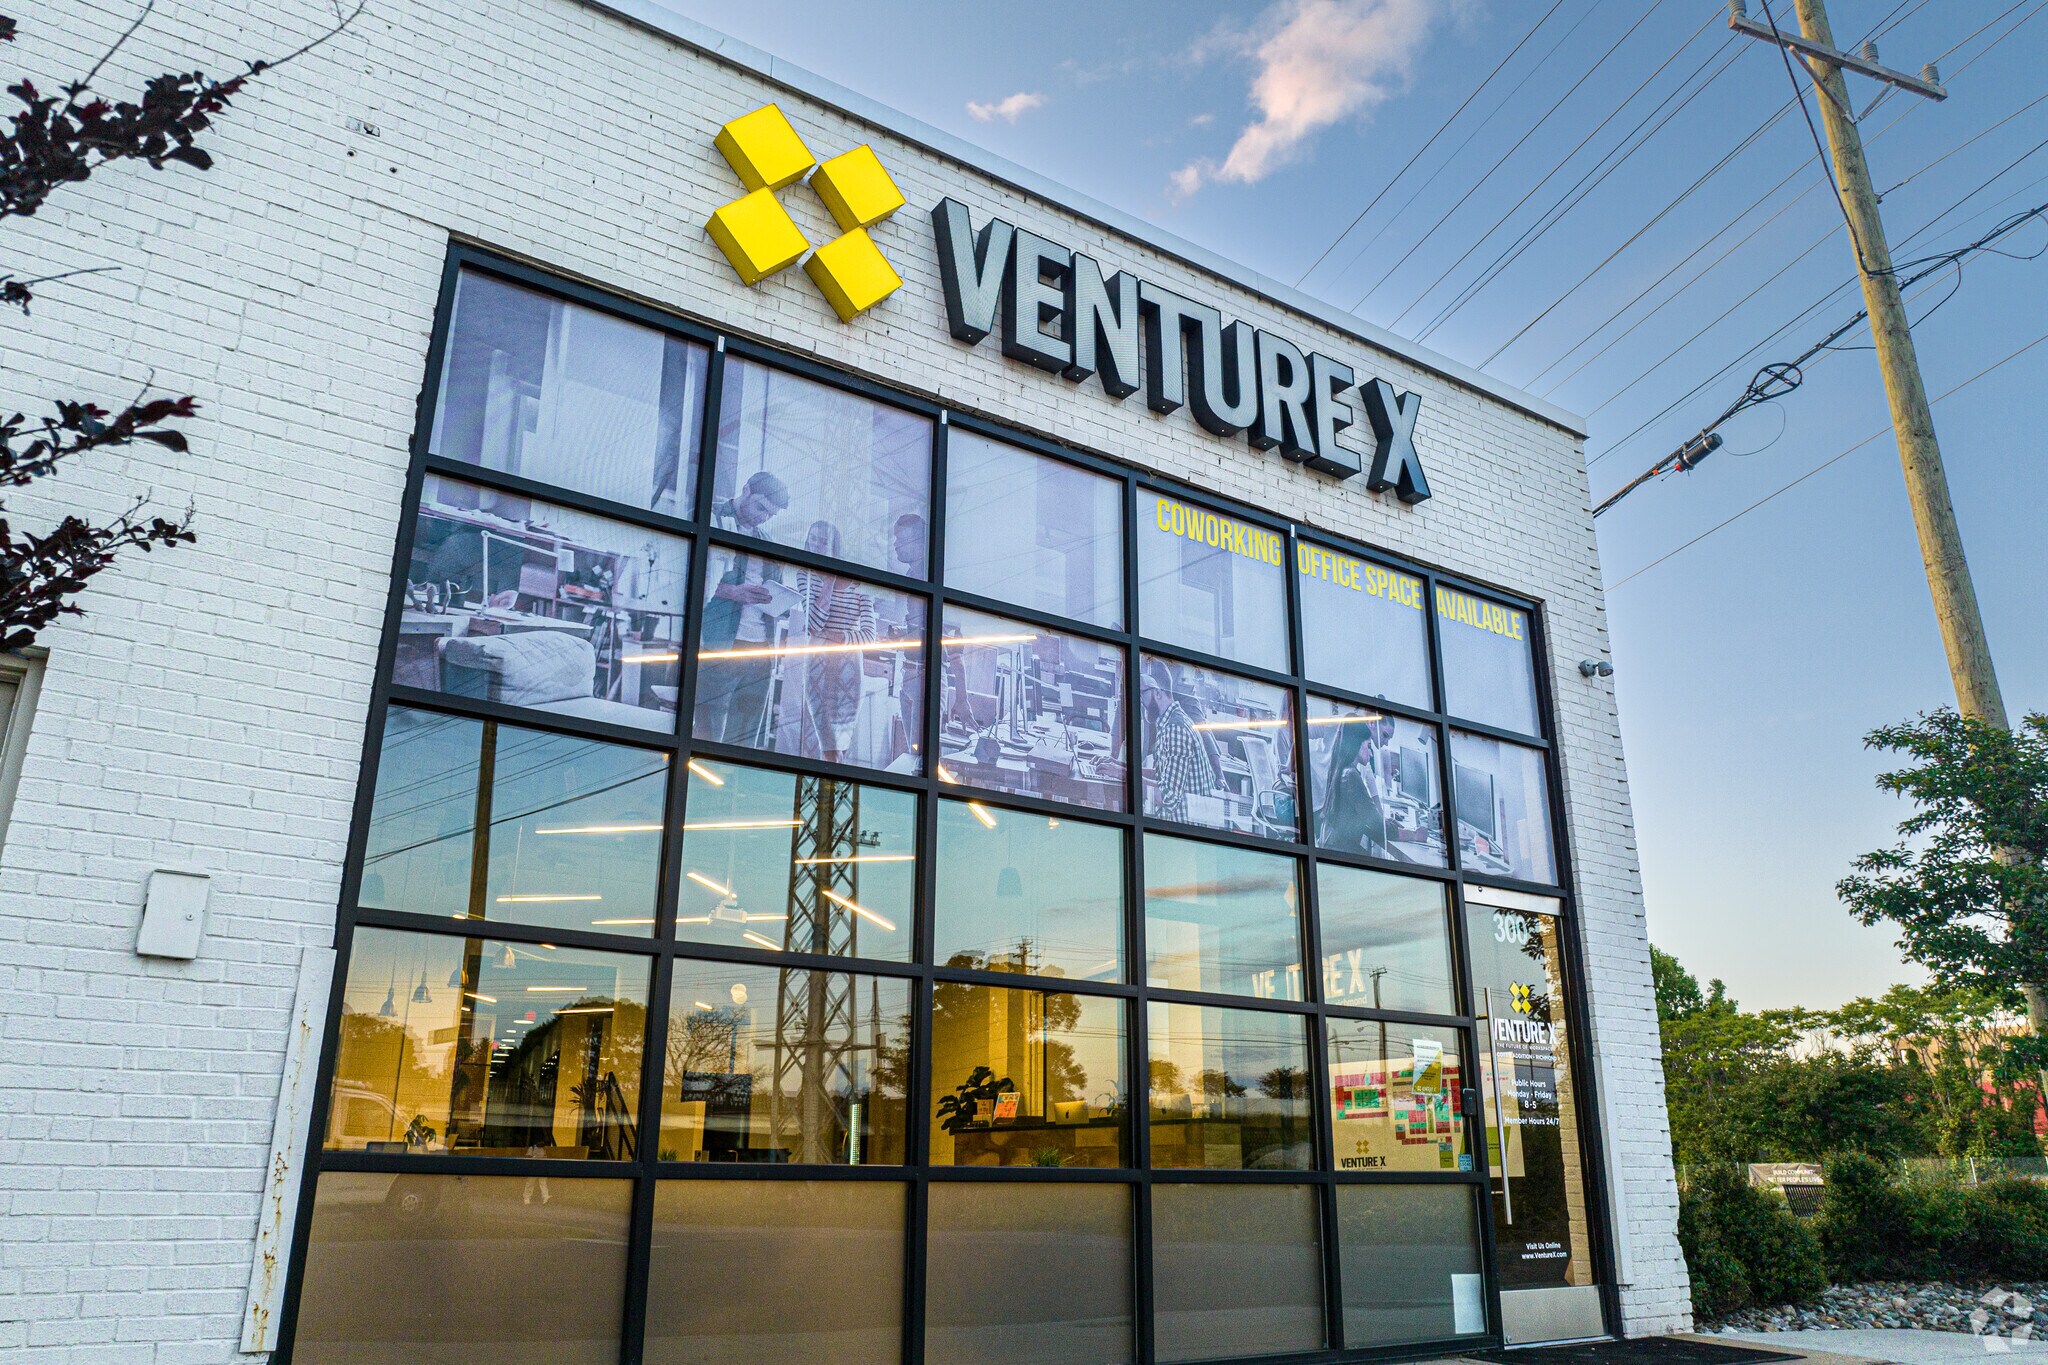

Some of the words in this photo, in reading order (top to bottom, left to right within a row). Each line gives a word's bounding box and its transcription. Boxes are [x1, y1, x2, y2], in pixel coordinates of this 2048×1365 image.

[931, 196, 1362, 480] VENTURE
[1359, 376, 1432, 506] X
[1156, 499, 1282, 567] COWORKING
[1297, 543, 1361, 592] OFFICE
[1365, 565, 1423, 611] SPACE
[1435, 588, 1523, 642] AVAILABLE
[1493, 912, 1528, 945] 300
[1252, 953, 1343, 1001] VETRE
[1547, 1022, 1558, 1045] X
[1511, 1079, 1529, 1087] Public
[1530, 1080, 1546, 1088] Hours
[1507, 1090, 1529, 1098] Monday
[1534, 1091, 1552, 1100] Friday
[1504, 1116, 1528, 1125] Member
[1528, 1117, 1545, 1125] Hours
[1546, 1117, 1560, 1126] 24/7
[1341, 1156, 1378, 1168] VENTURE
[1379, 1156, 1387, 1167] X
[1525, 1242, 1538, 1250] Visit
[1545, 1241, 1561, 1249] Online
[1521, 1251, 1567, 1259] www.VentureX.com
